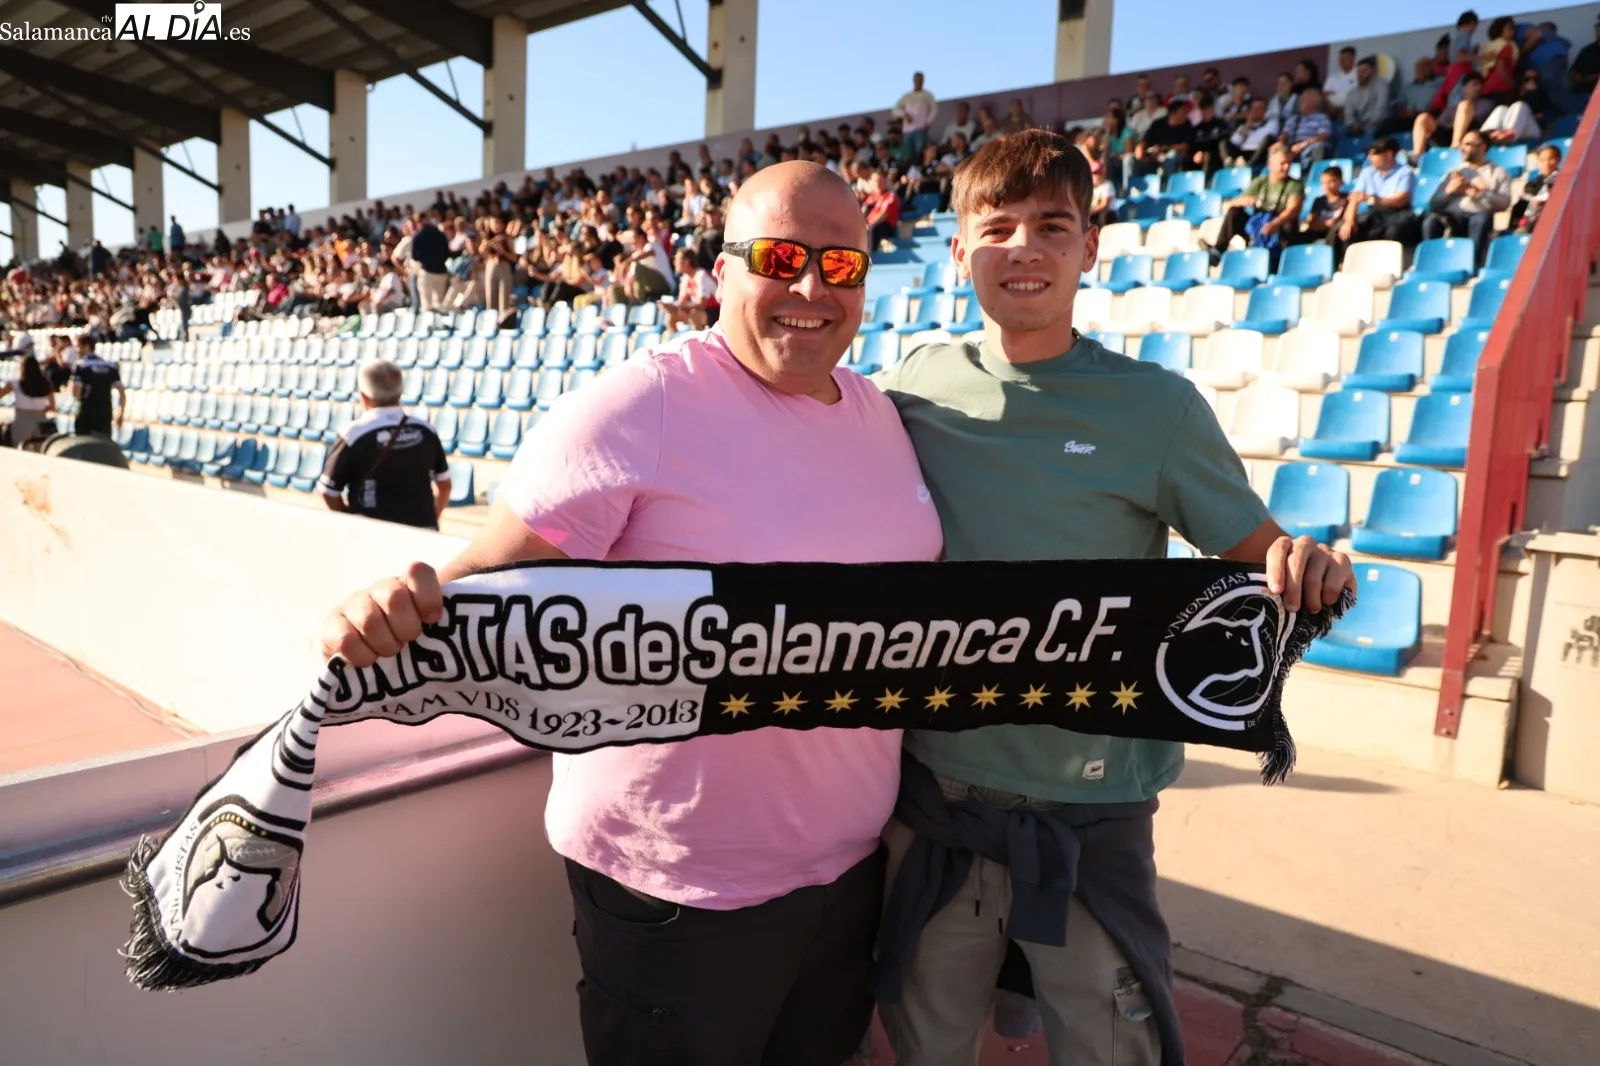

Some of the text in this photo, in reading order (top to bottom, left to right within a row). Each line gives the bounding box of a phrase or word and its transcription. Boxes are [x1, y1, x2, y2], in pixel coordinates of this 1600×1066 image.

[594, 604, 680, 685] de
[685, 599, 1031, 681] Salamanca
[1035, 597, 1132, 663] C.F.
[456, 690, 521, 722] VDS
